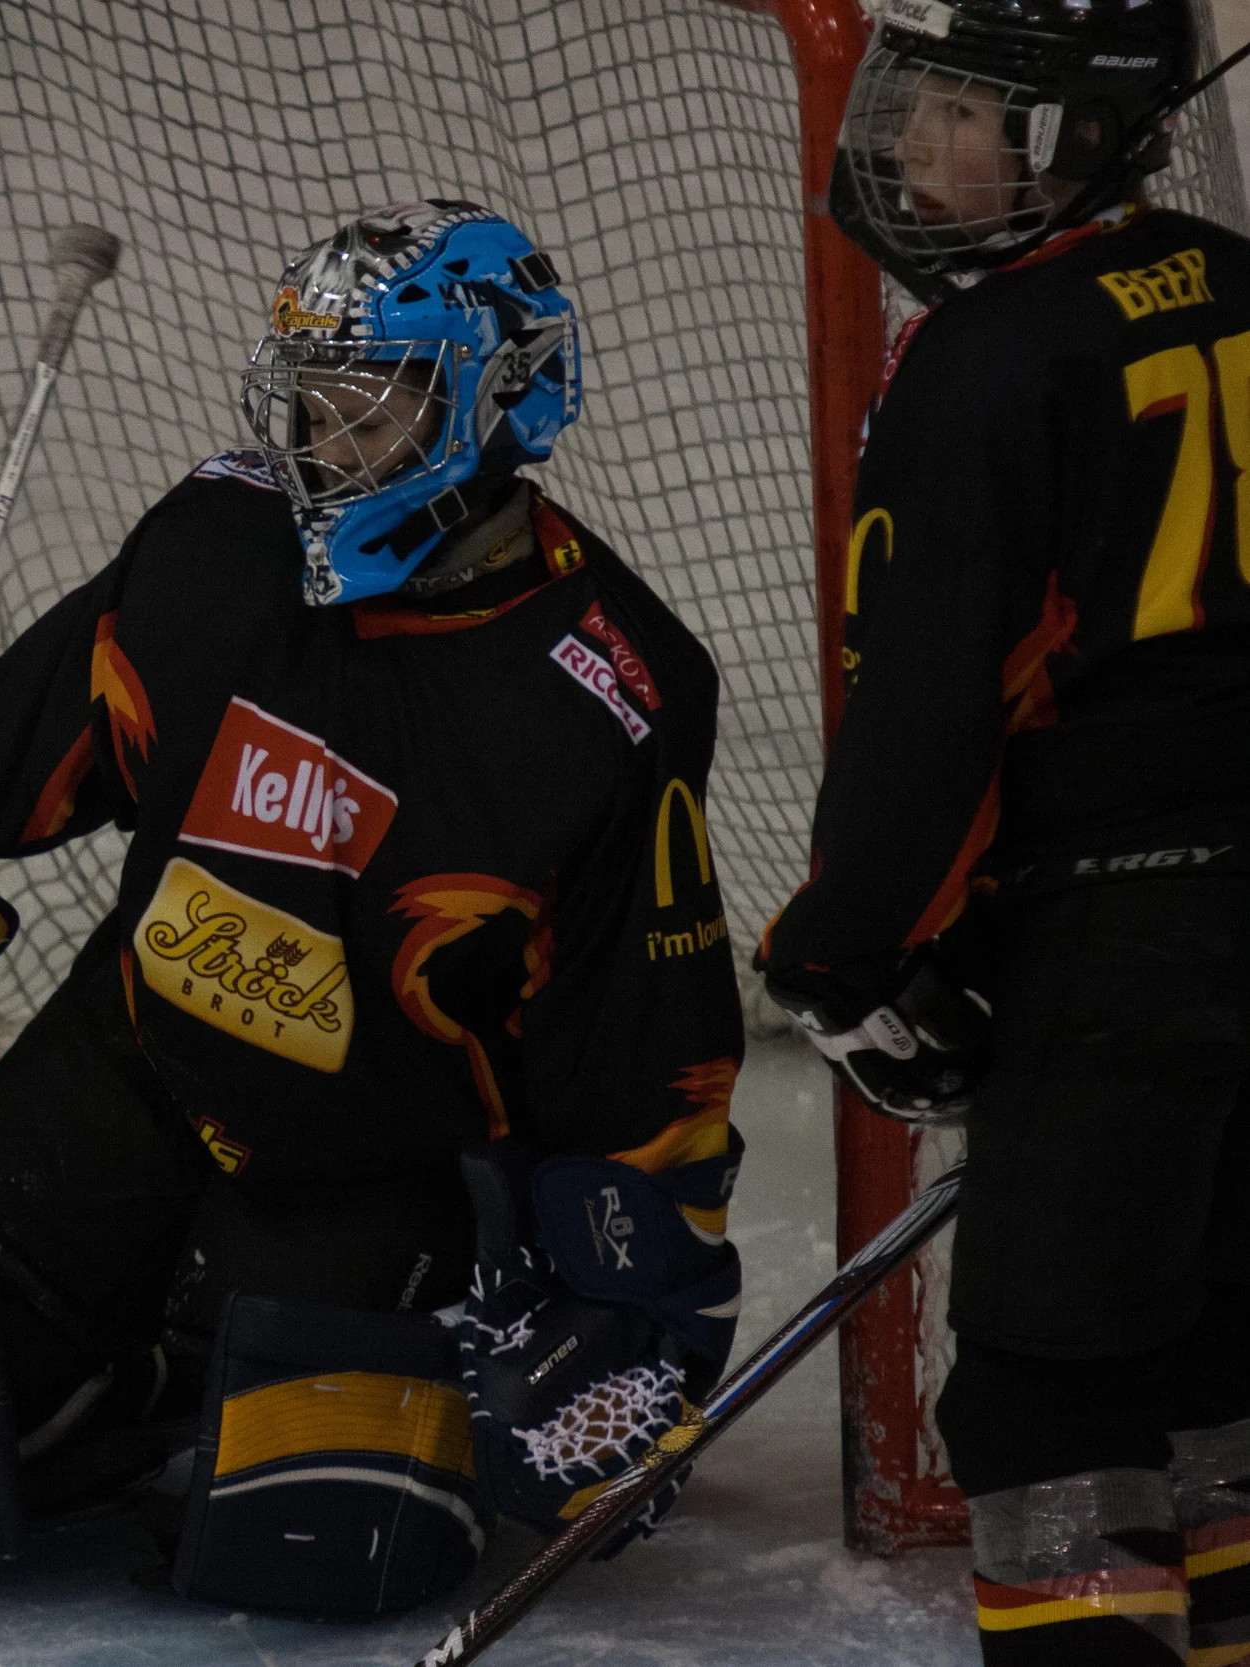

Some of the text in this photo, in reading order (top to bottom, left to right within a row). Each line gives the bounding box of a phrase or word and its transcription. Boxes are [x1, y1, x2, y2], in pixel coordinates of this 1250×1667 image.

[1090, 54, 1159, 70] BAUER
[1096, 248, 1215, 321] BEER
[502, 352, 531, 384] 35
[231, 742, 361, 852] Kelly's
[145, 890, 342, 1032] Ströck
[646, 930, 694, 961] i'm
[181, 977, 286, 1038] BROT
